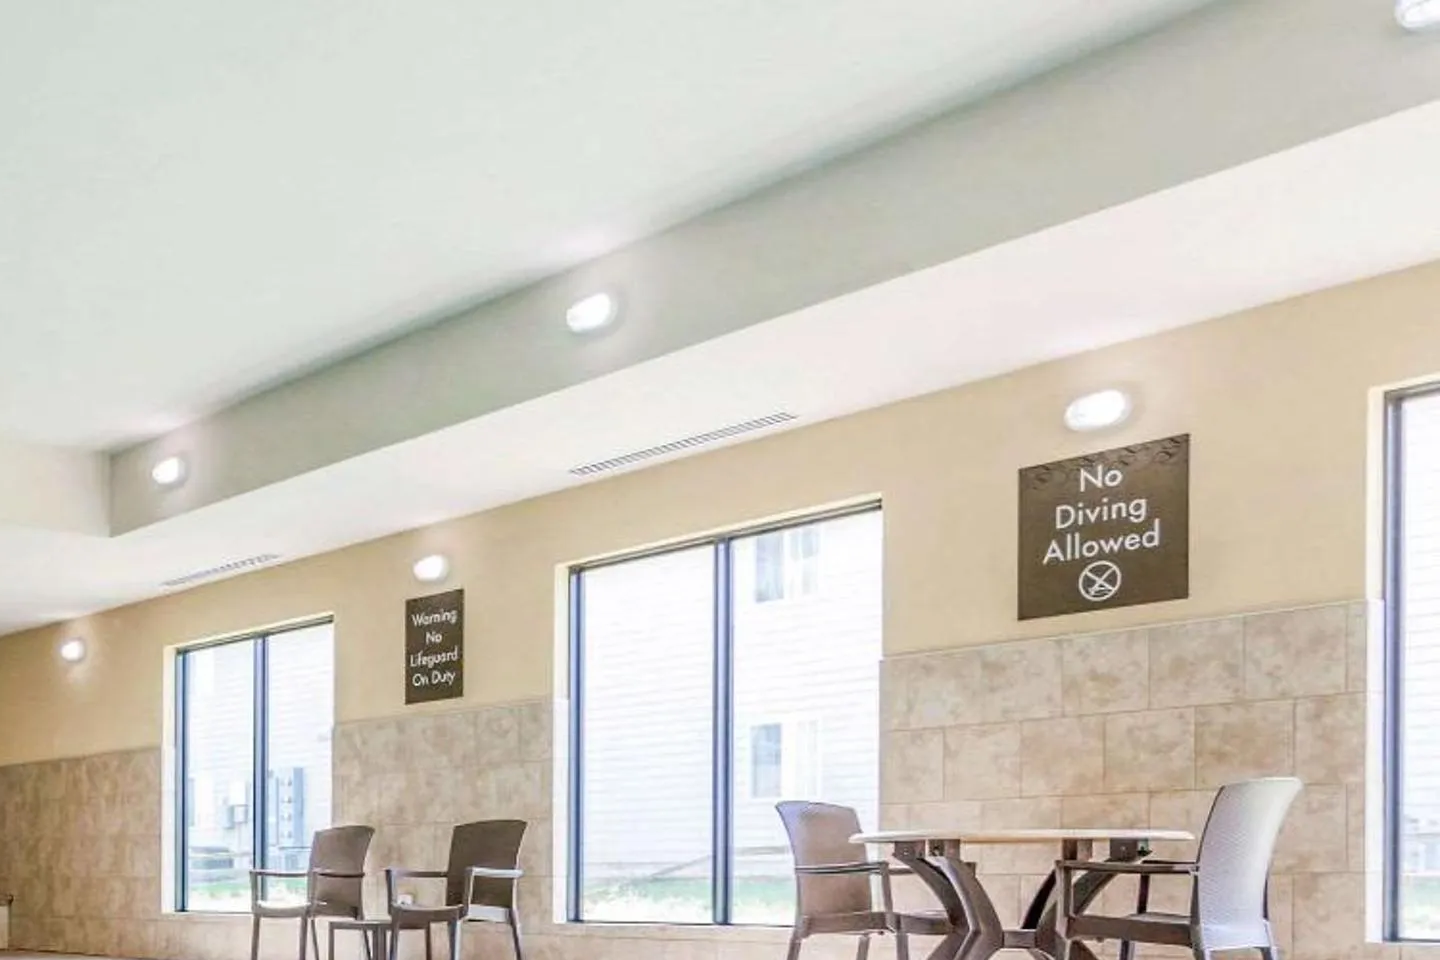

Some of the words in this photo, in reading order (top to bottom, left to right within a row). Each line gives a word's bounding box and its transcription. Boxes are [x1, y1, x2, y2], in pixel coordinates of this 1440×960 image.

[1079, 464, 1123, 492] No
[1055, 498, 1147, 529] Diving
[1042, 518, 1160, 565] Allowed
[411, 608, 458, 627] Warning
[425, 631, 443, 644] No
[410, 645, 458, 668] Lifeguard
[412, 673, 429, 687] On
[431, 670, 456, 686] Duty
